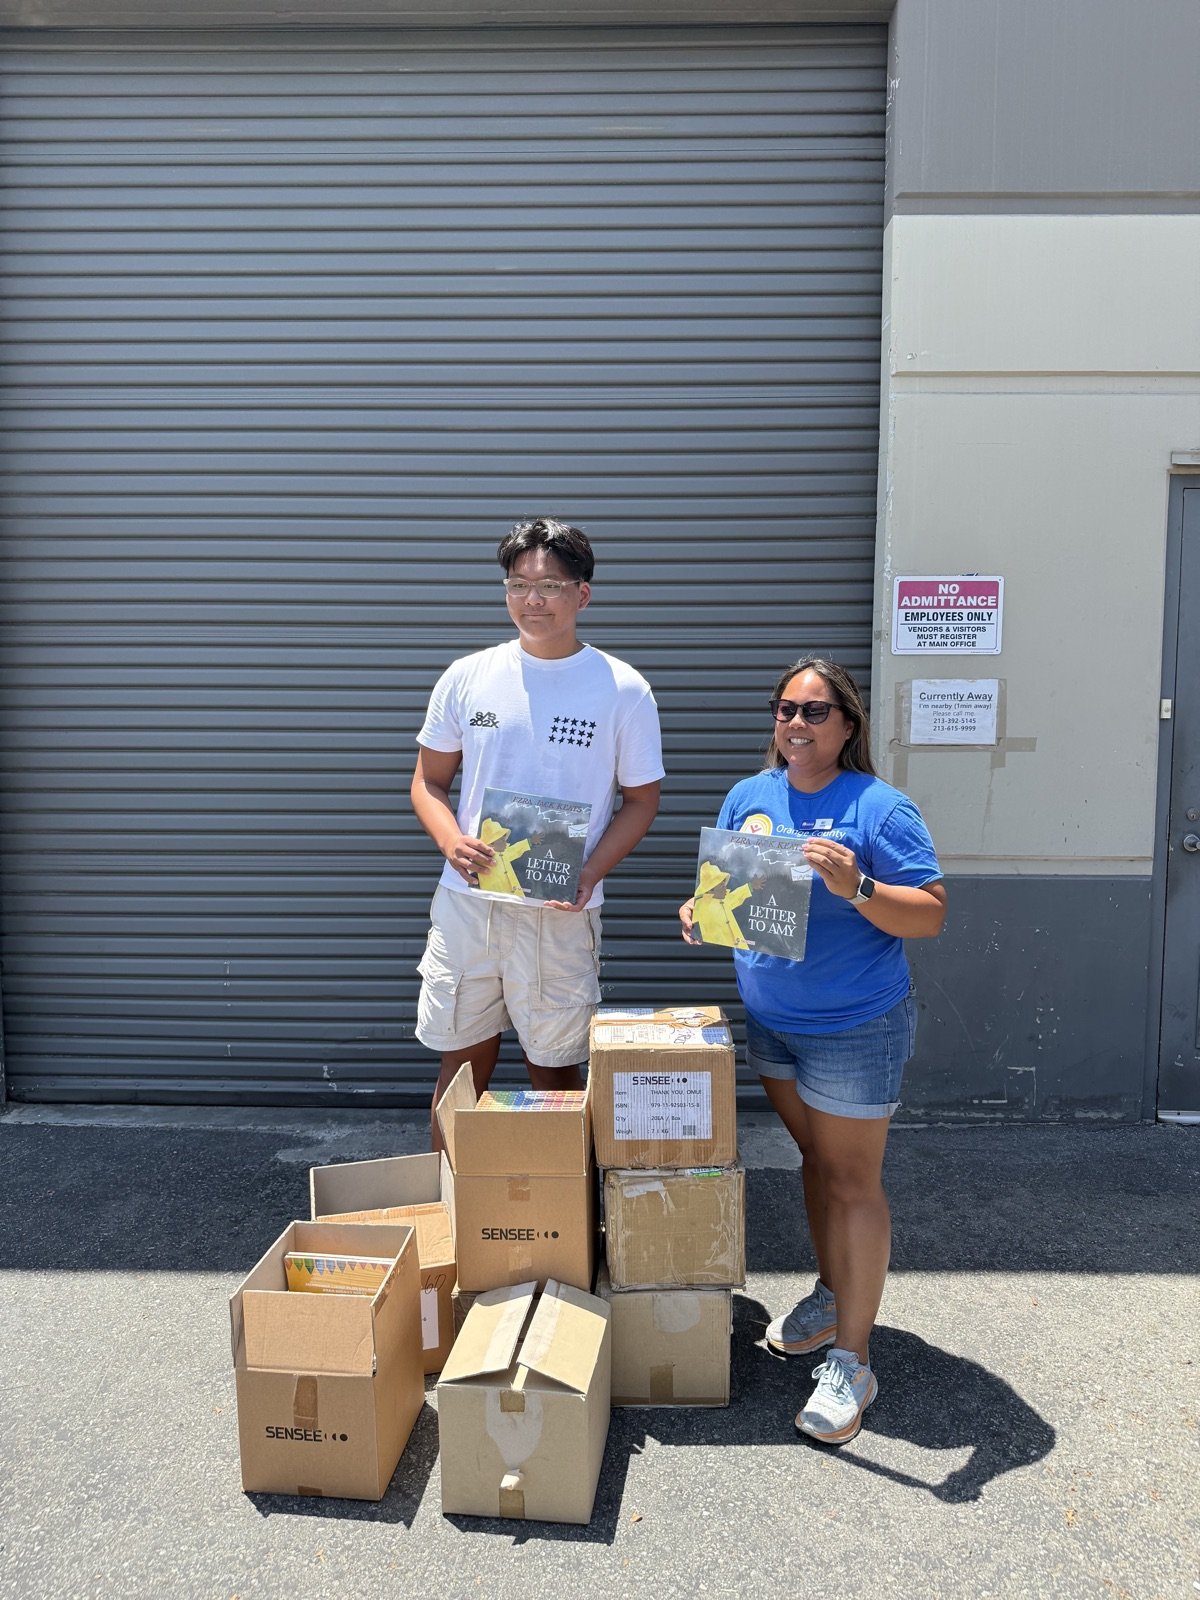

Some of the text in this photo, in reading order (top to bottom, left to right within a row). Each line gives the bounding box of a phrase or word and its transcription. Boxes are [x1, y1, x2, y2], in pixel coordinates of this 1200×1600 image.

[938, 584, 960, 594] NO
[900, 595, 997, 607] ADMITTANCE
[904, 612, 993, 621] EMPLOYEES ONLY
[919, 692, 993, 702] Currently Away
[469, 718, 499, 728] 202X
[776, 824, 809, 837] Orange
[812, 829, 847, 840] County
[755, 839, 774, 848] JAK
[544, 849, 555, 859] A
[527, 858, 571, 875] LETTER
[525, 869, 571, 885] TO AMY
[766, 894, 779, 906] A
[749, 905, 797, 925] LETTER
[748, 918, 797, 937] TO AMY
[632, 1076, 670, 1085] SENSEE
[481, 1228, 535, 1241] SENSEE
[265, 1426, 323, 1442] SENSEE
